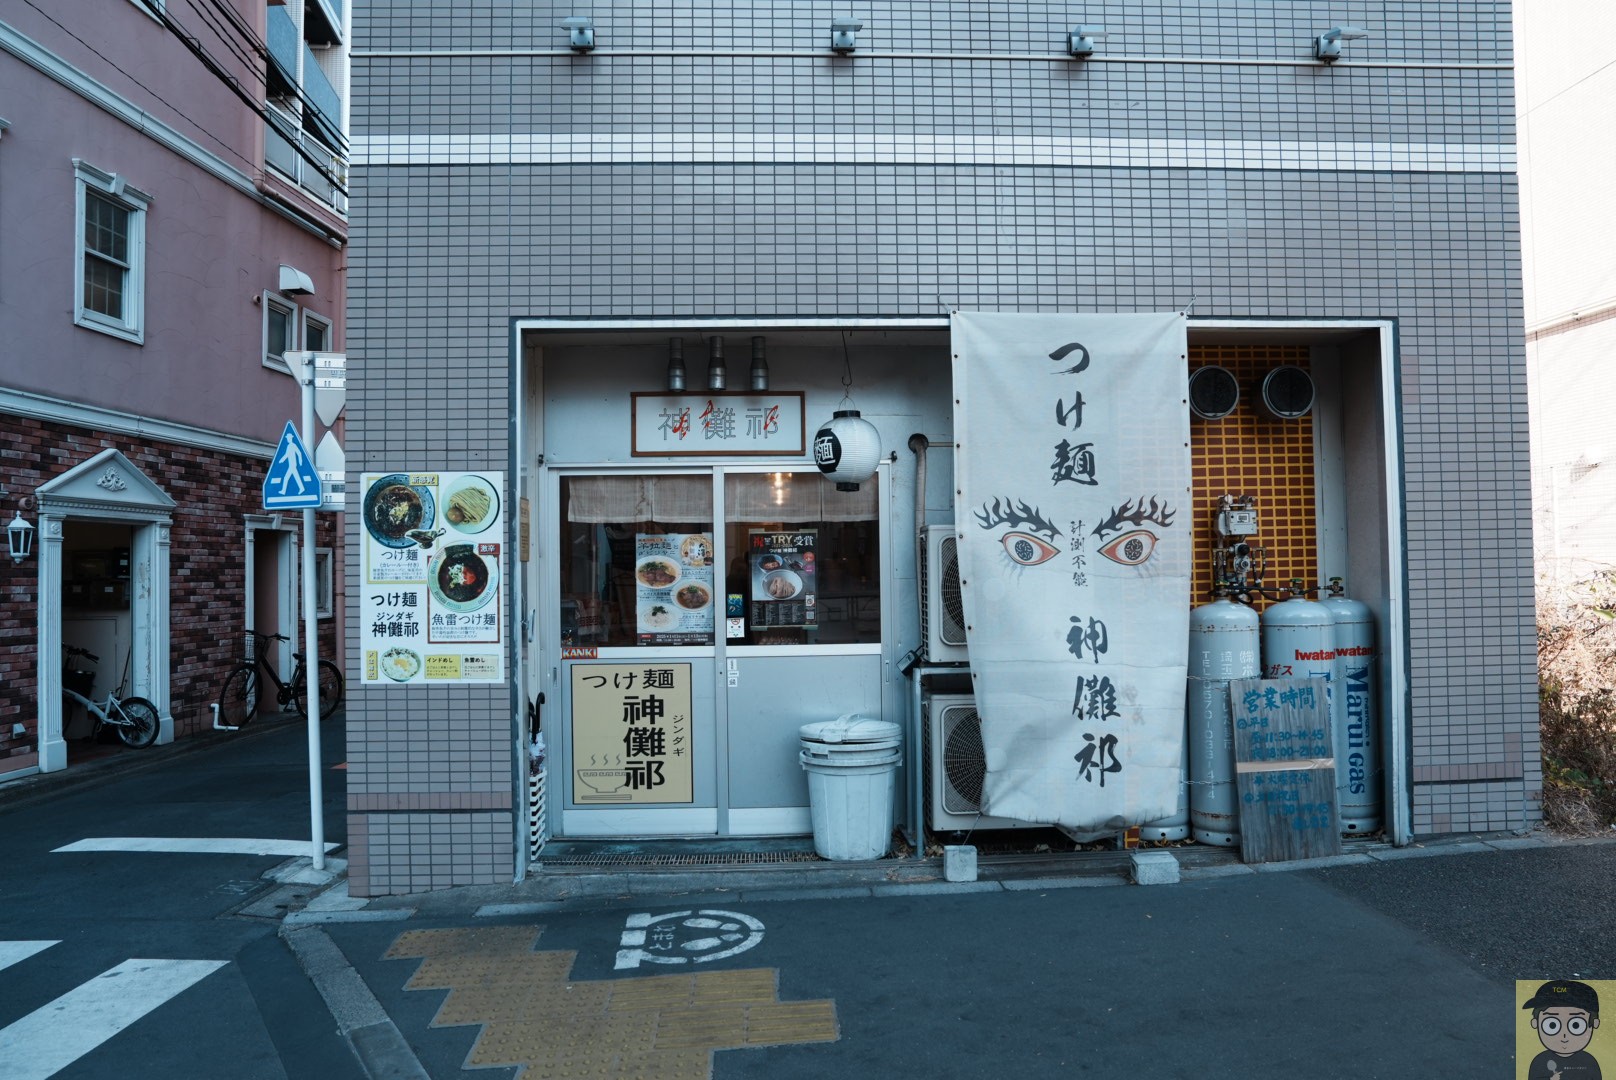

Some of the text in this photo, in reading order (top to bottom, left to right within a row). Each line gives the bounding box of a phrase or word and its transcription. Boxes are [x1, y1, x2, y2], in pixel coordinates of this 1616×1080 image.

[1049, 342, 1098, 486] つけ麺
[772, 535, 793, 544] TRY
[793, 535, 814, 546] 受賞
[381, 549, 418, 561] つけ麺
[371, 591, 418, 607] つけ麺
[376, 612, 414, 621] ジンダギ
[432, 613, 496, 626] 魚雷つけ麺
[562, 649, 597, 658] KANKI
[582, 668, 675, 689] つけ麺
[1243, 685, 1316, 714] 営業時間
[1346, 665, 1370, 750] Marui
[622, 694, 667, 790] 神儺祁
[673, 714, 685, 757] ジンダギ
